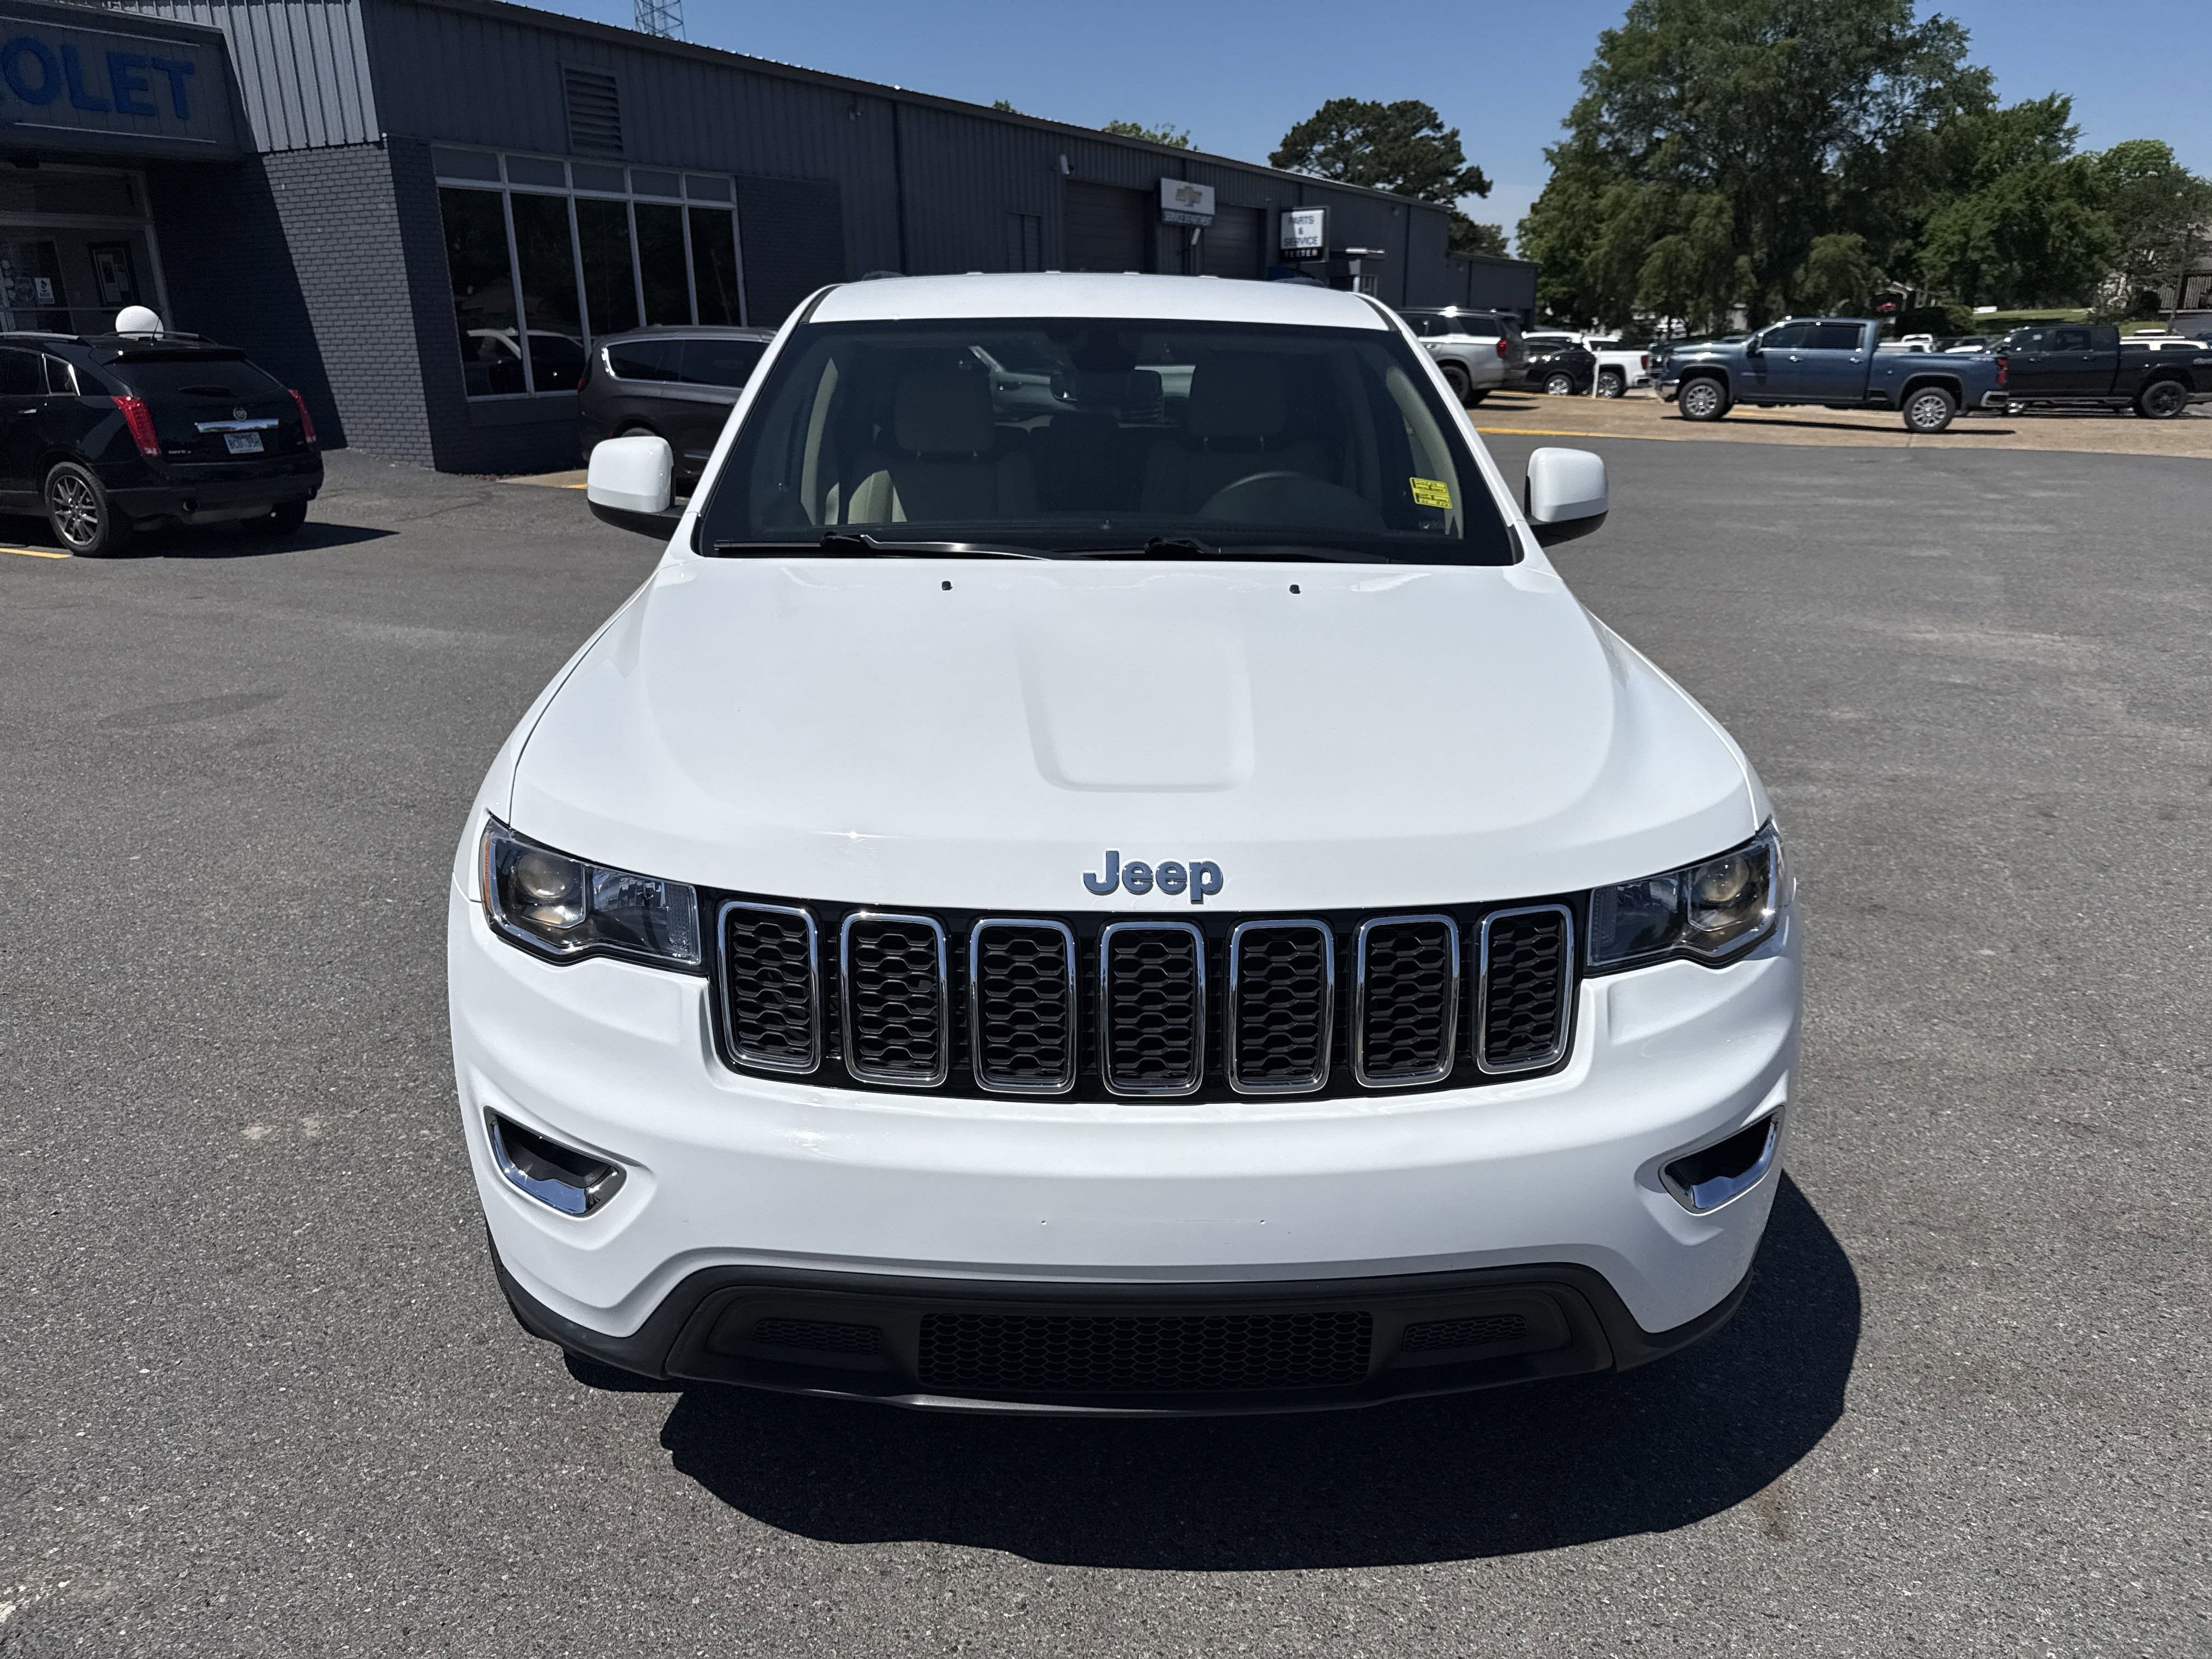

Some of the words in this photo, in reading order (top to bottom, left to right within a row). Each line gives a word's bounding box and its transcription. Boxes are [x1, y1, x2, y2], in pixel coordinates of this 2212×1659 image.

[0, 35, 195, 120] OLET
[1288, 216, 1314, 225] PARTS
[1298, 227, 1304, 235] &
[1284, 236, 1318, 247] SERVICE
[1082, 848, 1224, 905] Jeep
